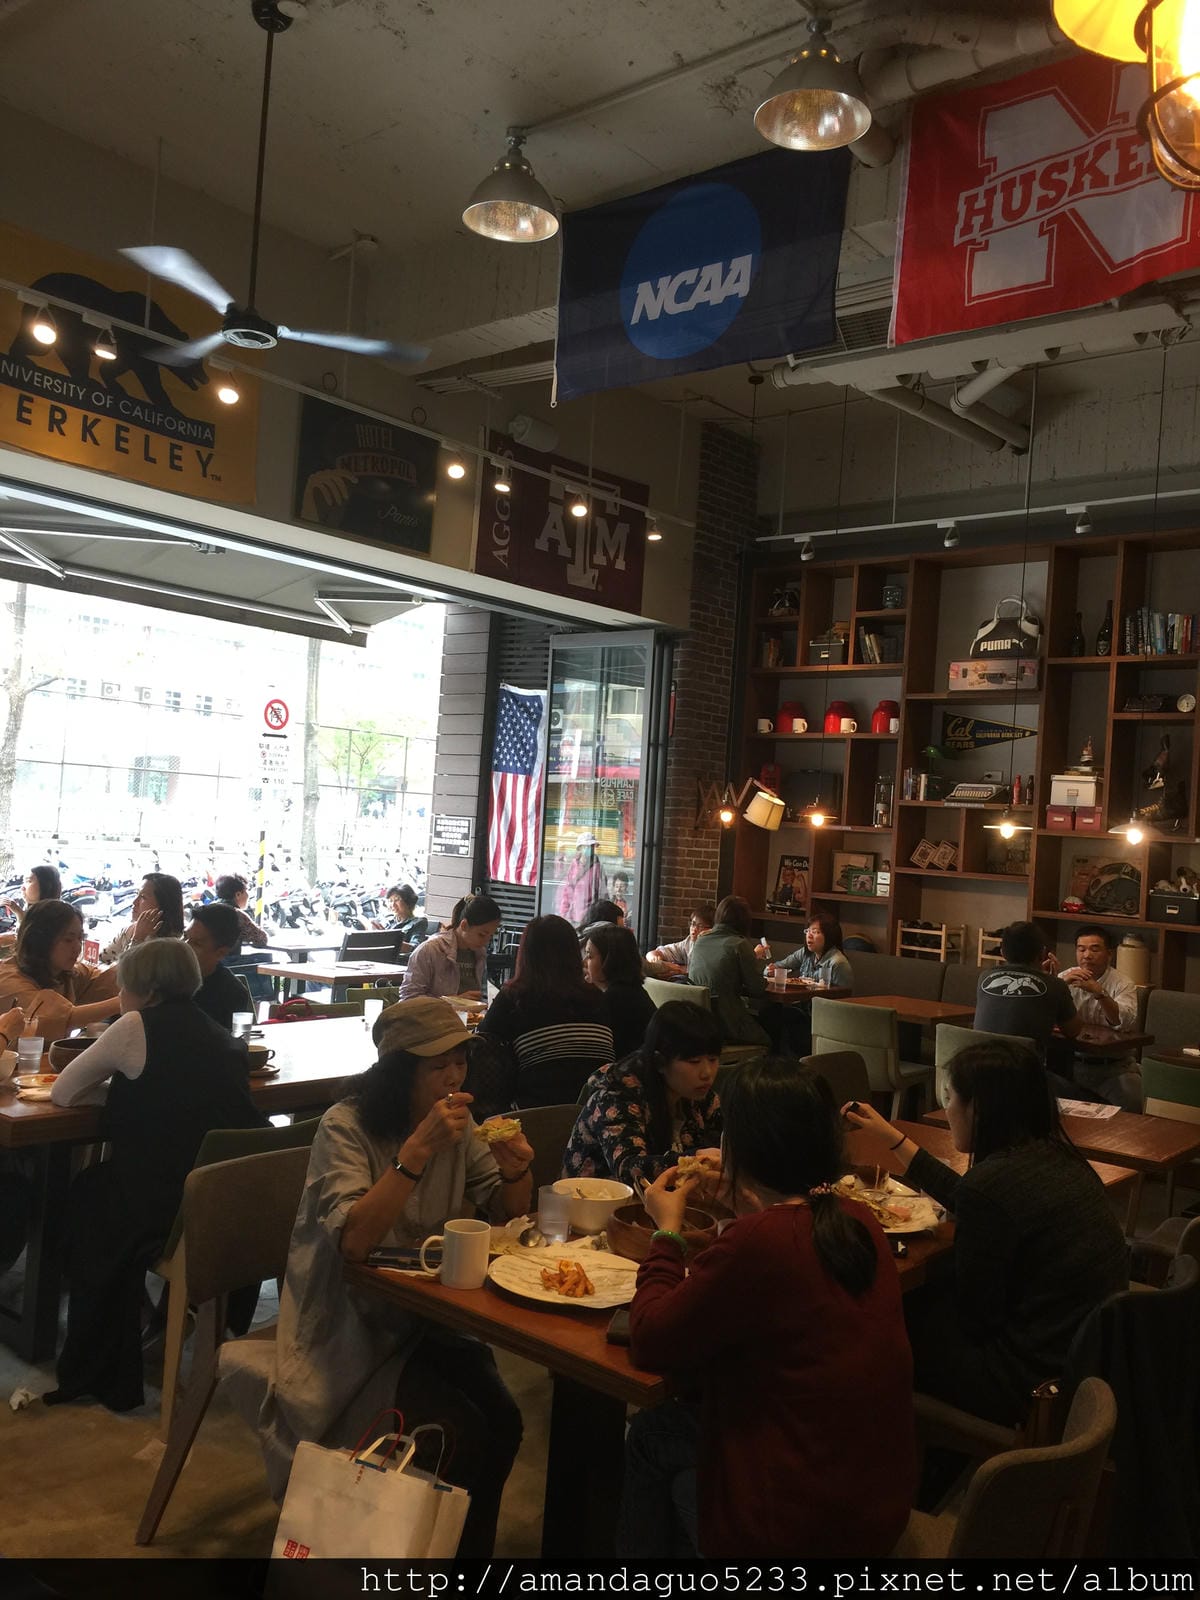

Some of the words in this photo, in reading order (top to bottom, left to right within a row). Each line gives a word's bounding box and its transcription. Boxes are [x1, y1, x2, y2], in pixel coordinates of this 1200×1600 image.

[958, 135, 1158, 240] HUSKE
[629, 253, 753, 326] NCAA
[0, 359, 87, 401] NIVERSITY
[91, 391, 114, 409] OF
[119, 399, 214, 442] CALIFORNIA
[15, 392, 214, 478] ERKELEY
[355, 423, 393, 449] HOTEL
[980, 639, 1012, 652] PUMA
[946, 717, 976, 738] Cal
